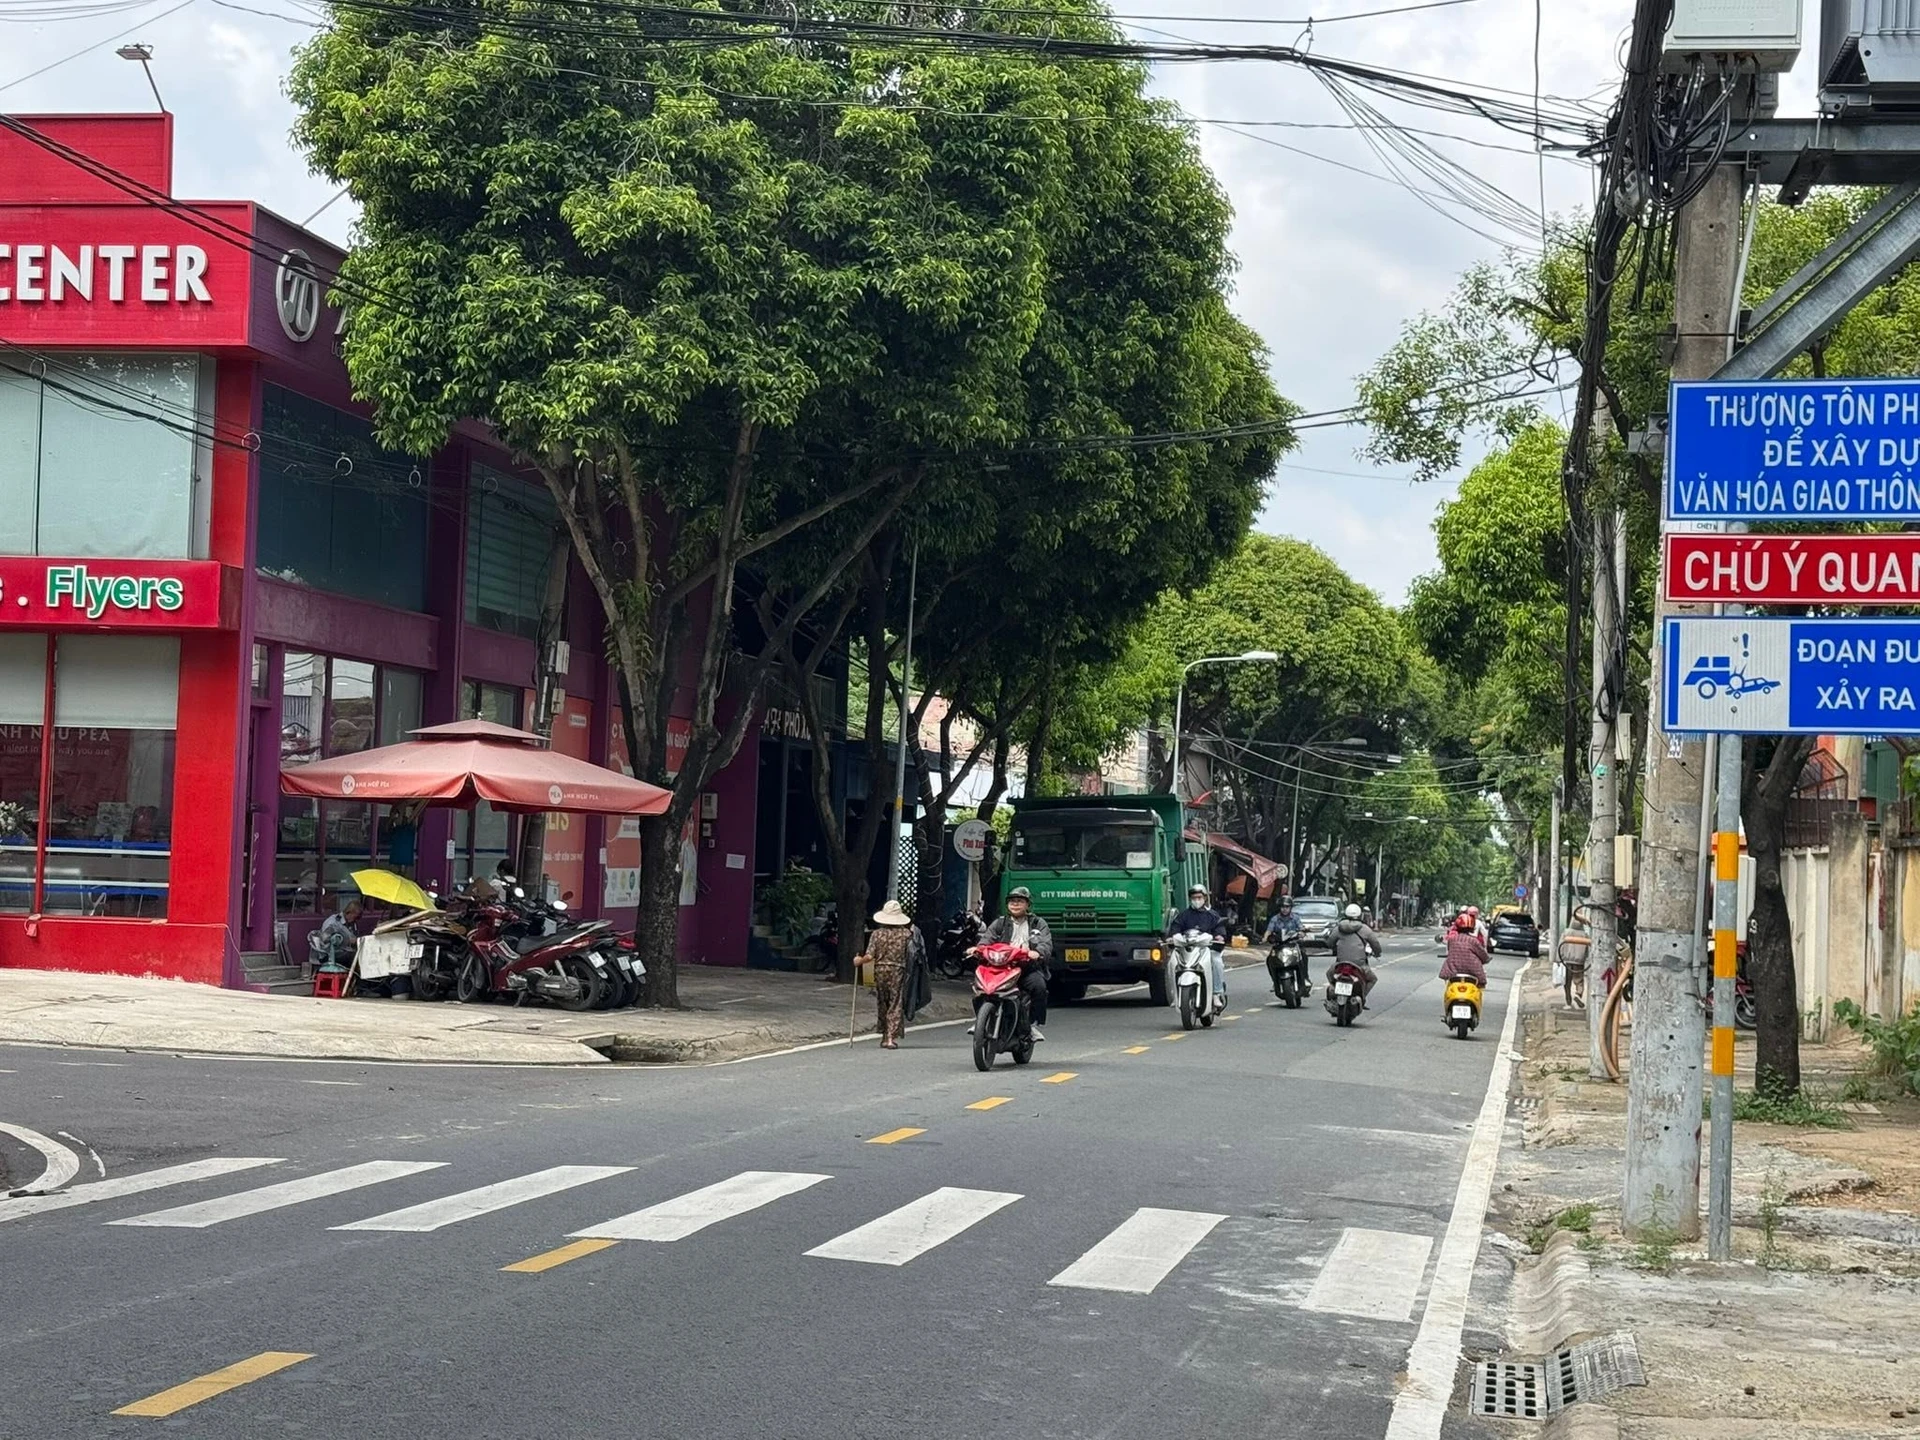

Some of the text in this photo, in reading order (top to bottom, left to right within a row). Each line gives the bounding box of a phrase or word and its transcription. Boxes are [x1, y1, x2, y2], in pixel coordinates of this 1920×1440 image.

[1706, 387, 1919, 434] THƯỢNG TÔN PH
[1763, 427, 1804, 467] ĐỂ
[1810, 433, 1871, 467] XÂY
[1679, 472, 1729, 511] VĂN
[1736, 471, 1787, 511] HÓA
[1793, 479, 1850, 511] GIAO
[1685, 540, 1770, 593] CHÚ
[1782, 540, 1808, 592] Ý
[46, 565, 183, 618] Flyers
[1797, 638, 1876, 668] ĐOẠN
[1816, 678, 1916, 710] XẢY RA
[79, 729, 110, 741] PEA
[1041, 890, 1056, 898] CTY
